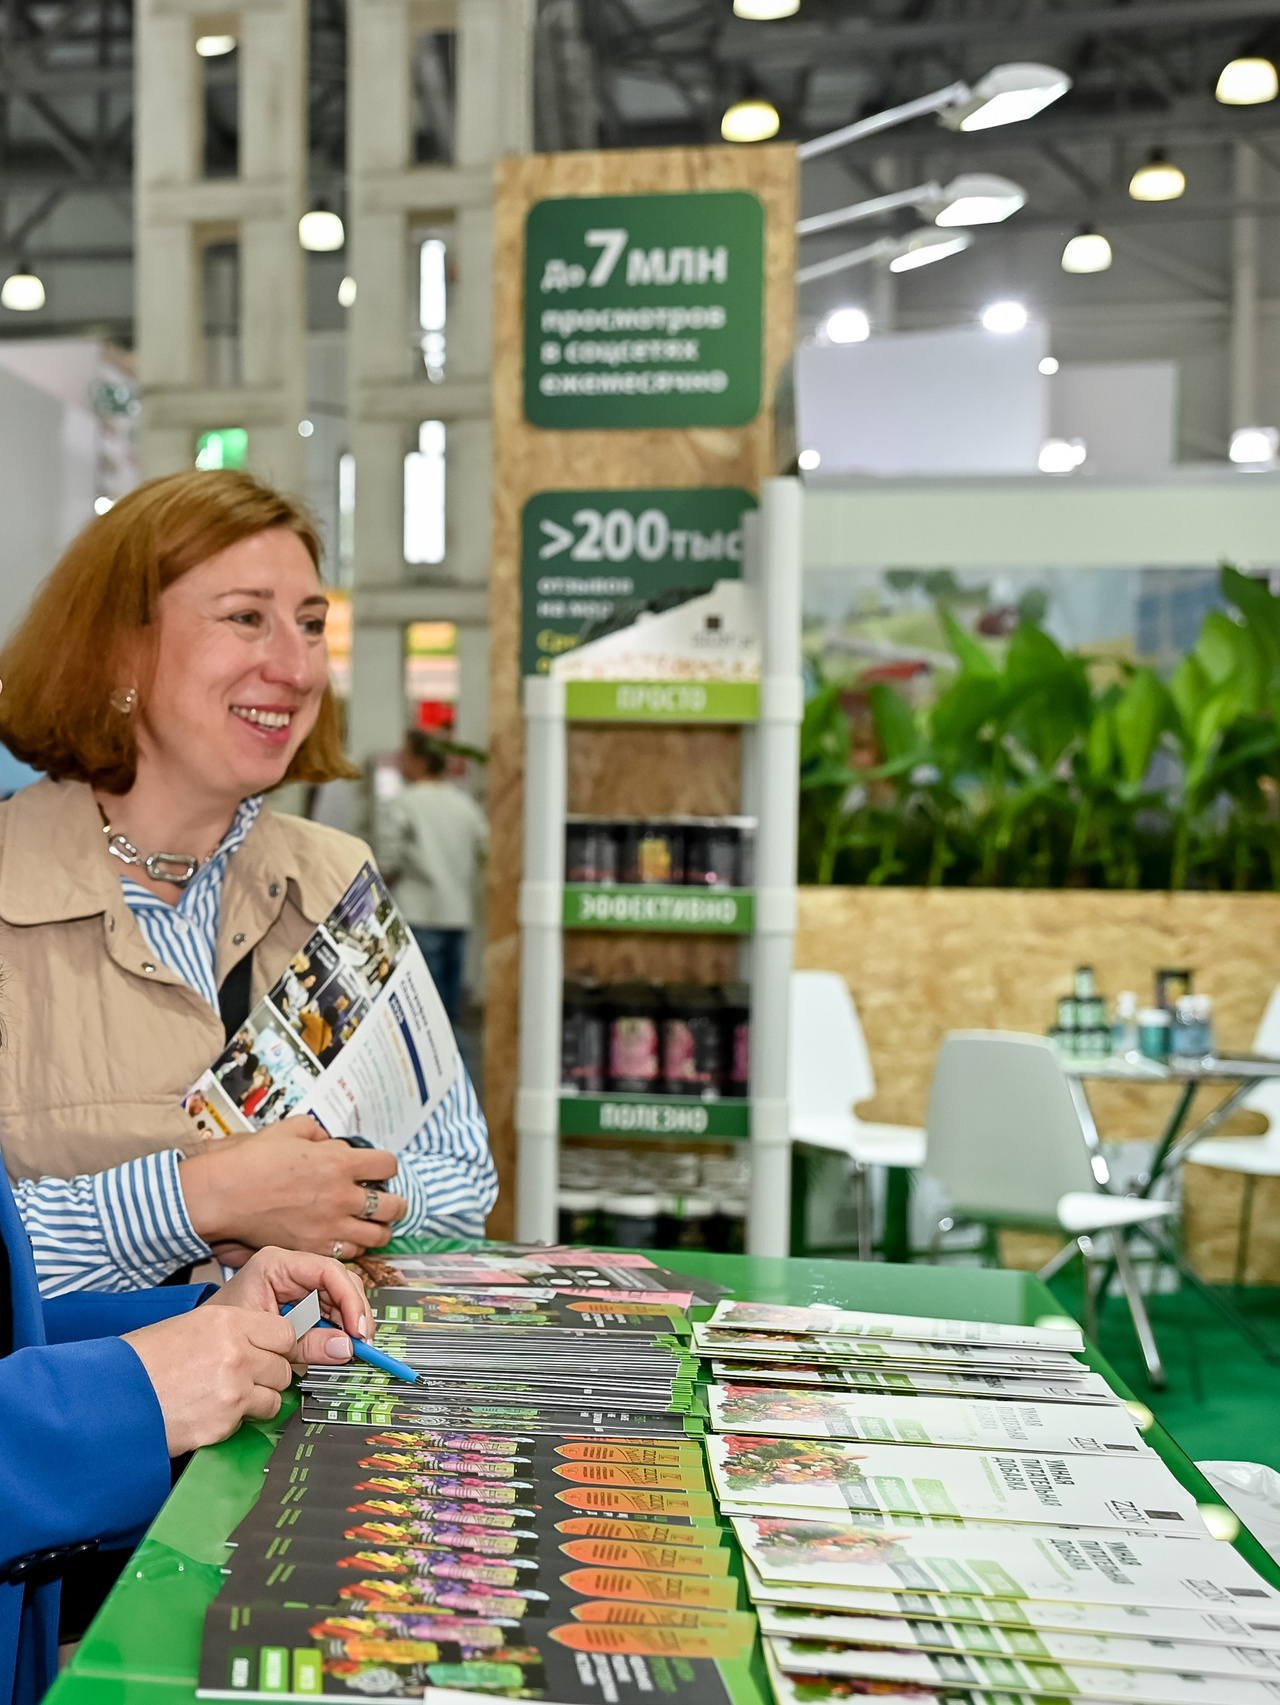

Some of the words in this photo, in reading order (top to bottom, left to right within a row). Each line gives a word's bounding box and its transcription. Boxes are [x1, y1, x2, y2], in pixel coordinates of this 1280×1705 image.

[540, 258, 586, 294] До
[584, 229, 628, 288] 7
[540, 306, 726, 339] просмотров
[539, 341, 562, 365] в
[563, 338, 700, 368] соцсетях
[538, 369, 730, 397] ежемесячно
[616, 685, 707, 713] ПРОСТО
[580, 893, 738, 924] ЭФФЕКТИВНО
[600, 1103, 709, 1134] ПОЛЕЗНО
[991, 1457, 1028, 1490] ДОБАВКА
[1020, 1458, 1063, 1507] ПИТАТЕЛЬНАЯ
[1044, 1459, 1075, 1485] УМНАЯ
